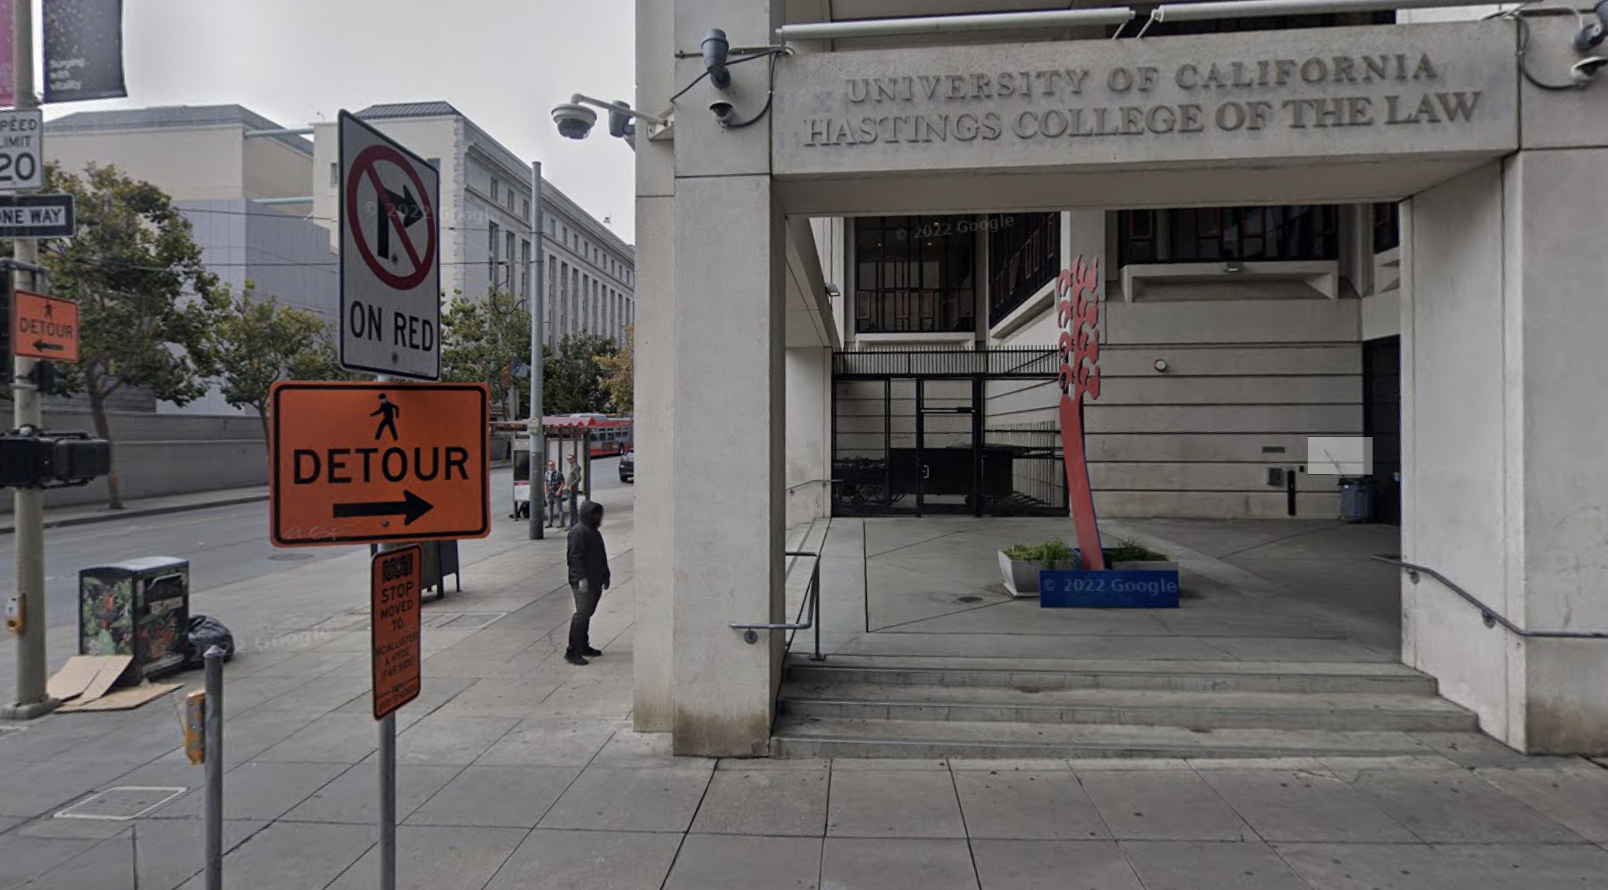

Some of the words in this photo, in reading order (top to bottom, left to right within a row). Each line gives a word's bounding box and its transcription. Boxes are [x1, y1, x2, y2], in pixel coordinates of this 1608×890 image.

[846, 68, 1088, 104] UNIVERSITY
[1106, 66, 1158, 93] OF
[1175, 52, 1439, 90] CALIFORNIA
[0, 119, 38, 132] PEED
[803, 111, 1002, 147] HASTINGS
[1012, 103, 1203, 139] COLLEGE
[1214, 101, 1270, 131] OF
[1283, 97, 1373, 127] THE
[1383, 91, 1483, 125] LAW
[0, 135, 32, 148] IMIT
[0, 152, 36, 181] 20
[30, 207, 61, 224] WAY
[20, 317, 73, 339] DETOUR
[350, 300, 382, 342] ON
[393, 311, 433, 352] RED
[293, 446, 470, 485] DETOUR
[381, 581, 413, 603] STOP
[380, 600, 413, 618] MOVED
[391, 619, 403, 630] TO
